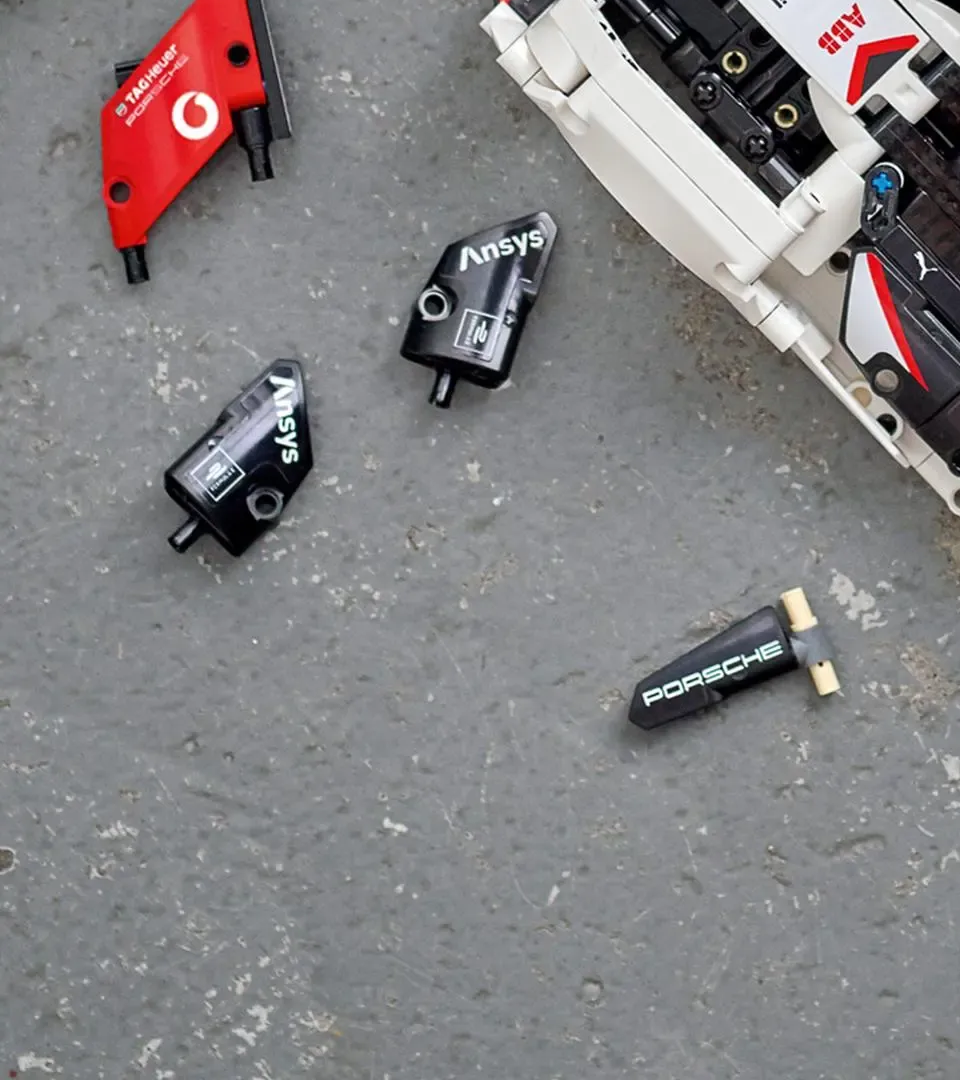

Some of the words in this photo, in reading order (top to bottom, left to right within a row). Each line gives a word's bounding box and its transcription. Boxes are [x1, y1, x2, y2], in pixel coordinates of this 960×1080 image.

[818, 2, 866, 55] ABB
[459, 229, 545, 272] Ansys
[269, 375, 299, 464] Ansys
[641, 640, 784, 708] PORSCHE
